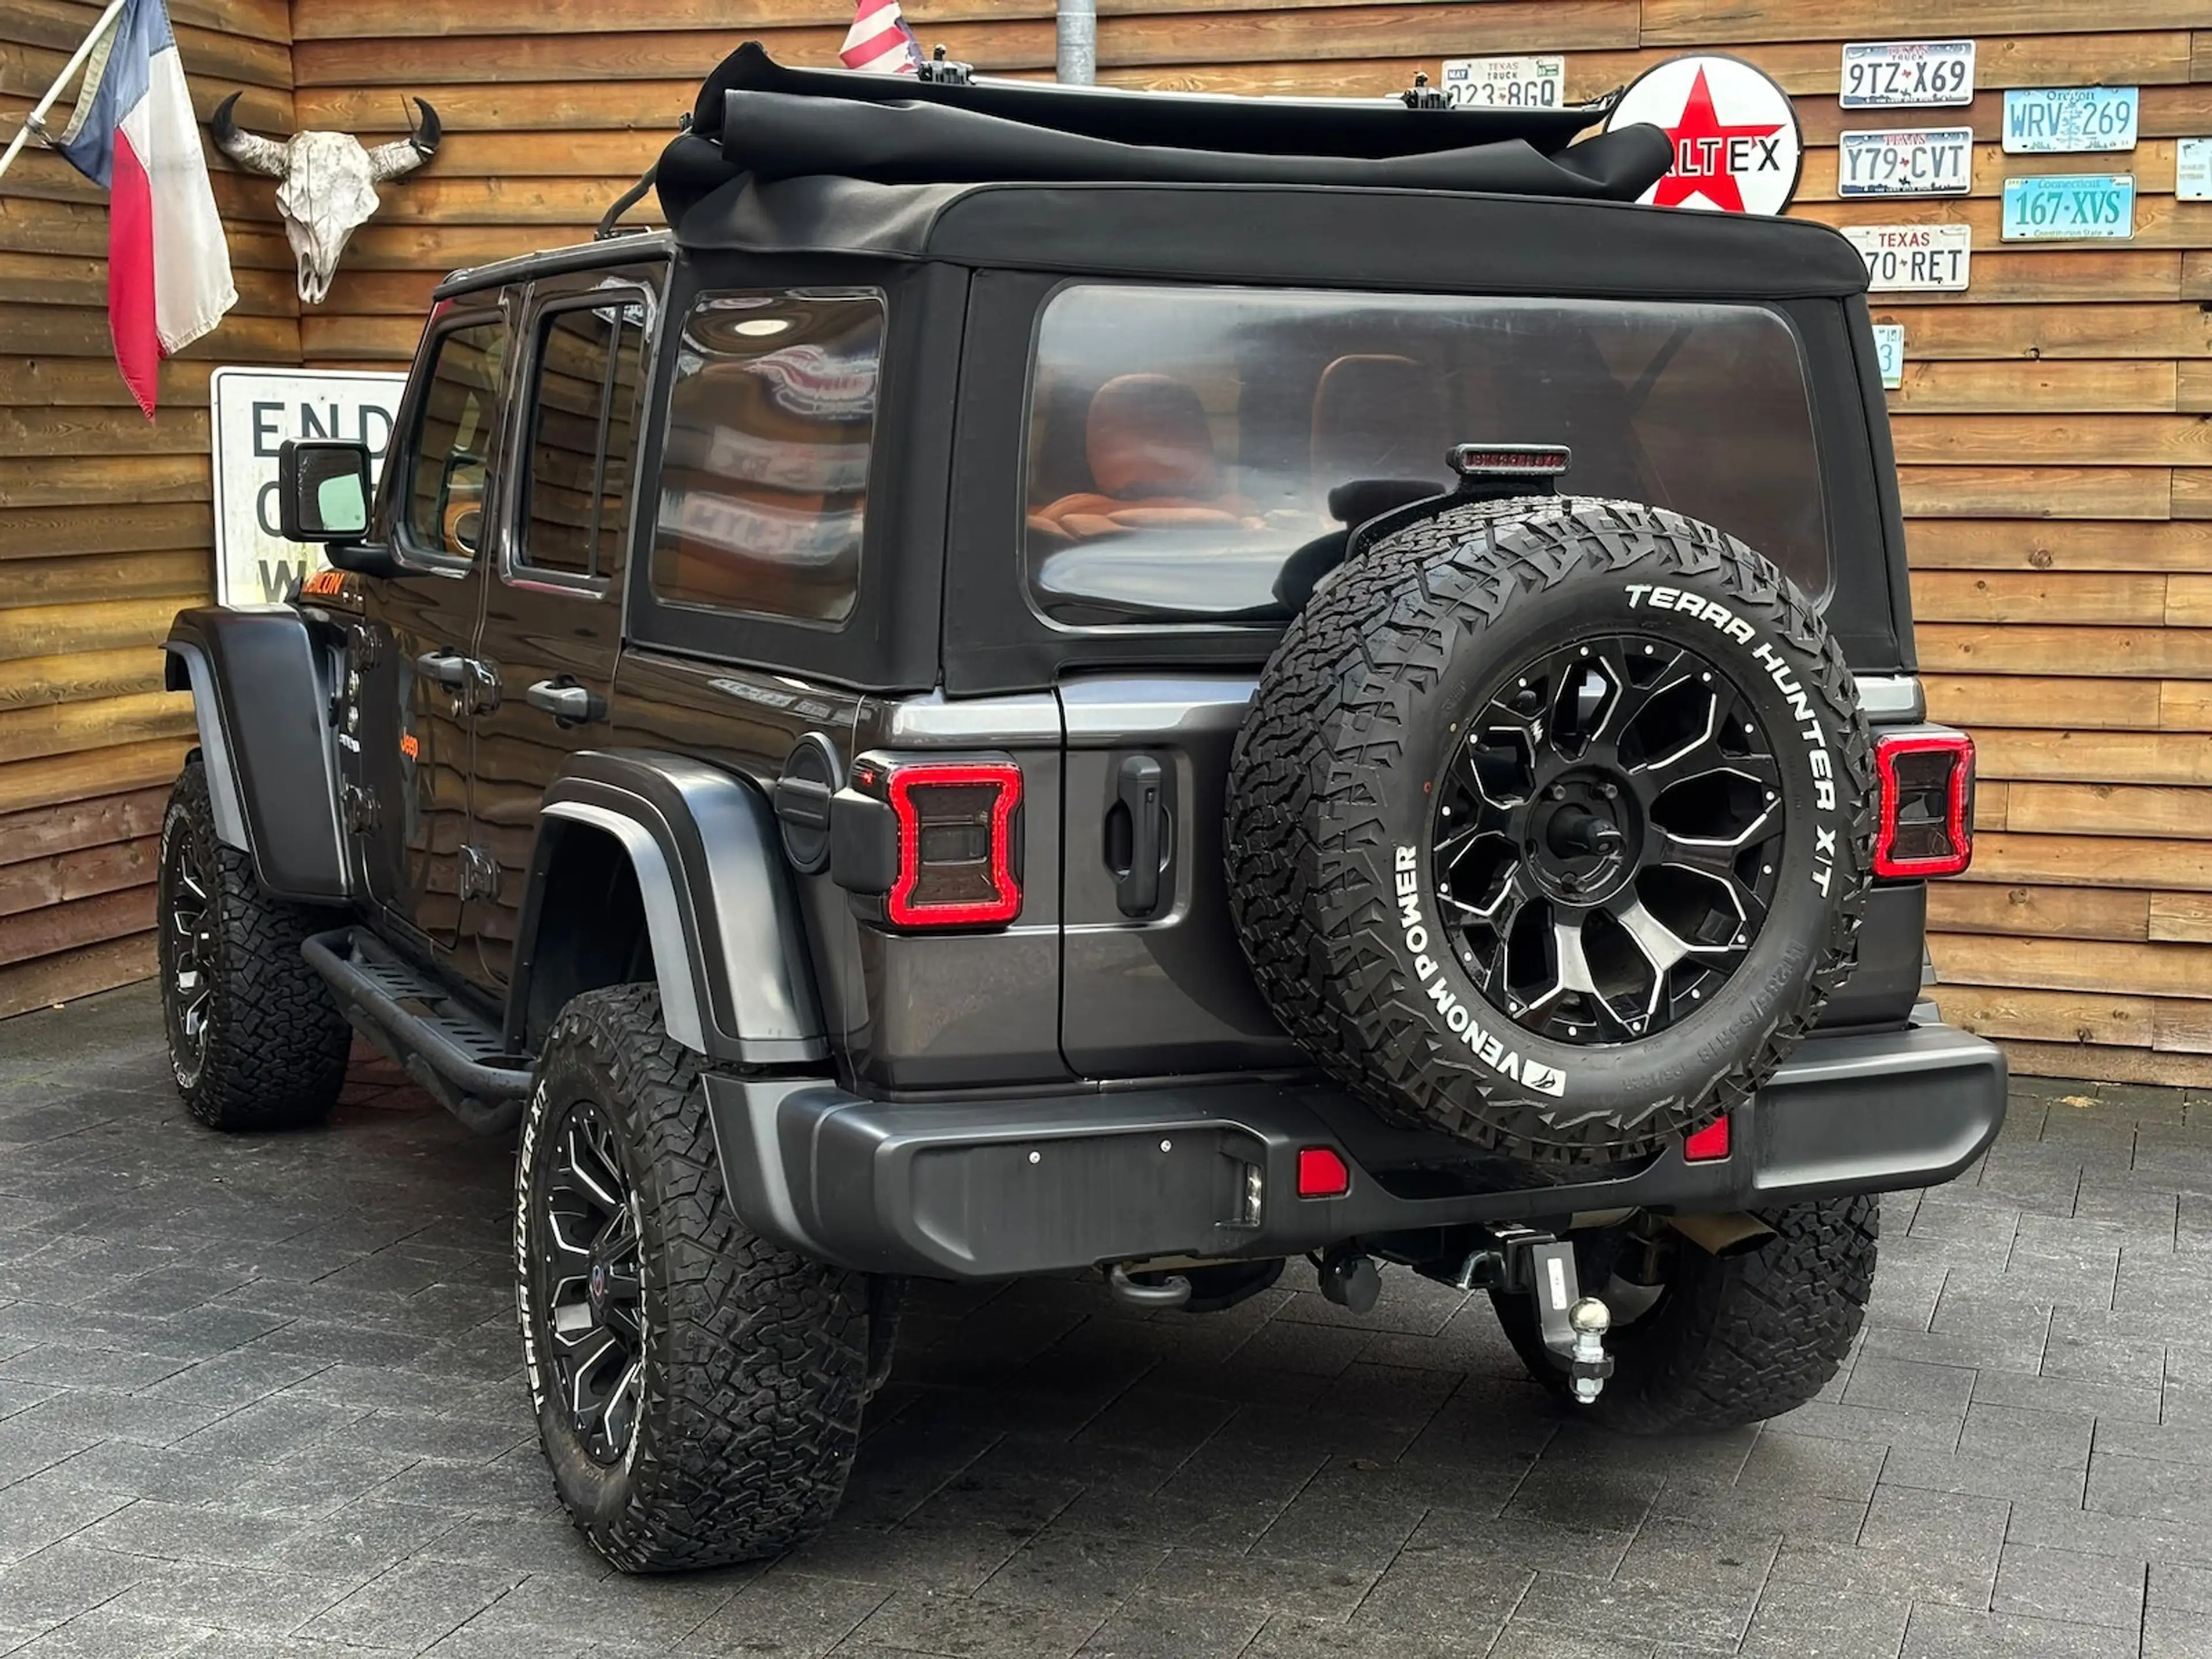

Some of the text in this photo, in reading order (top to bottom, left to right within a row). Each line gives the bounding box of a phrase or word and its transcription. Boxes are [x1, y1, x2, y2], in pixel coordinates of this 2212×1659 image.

[1487, 71, 1518, 80] TRUCK
[1488, 62, 1519, 70] TEXAS
[1850, 60, 1965, 94] 9TZ X69
[2010, 101, 2130, 138] WRV 269
[1666, 137, 1781, 176] LTEX
[1848, 145, 1964, 180] Y79 CVT
[1878, 232, 1930, 248] TEXAS
[1865, 249, 1963, 282] 70 RET
[1625, 585, 1756, 645] TERRA
[1752, 642, 1836, 811] HUNTER
[1395, 845, 1519, 1083] VENOM POWER
